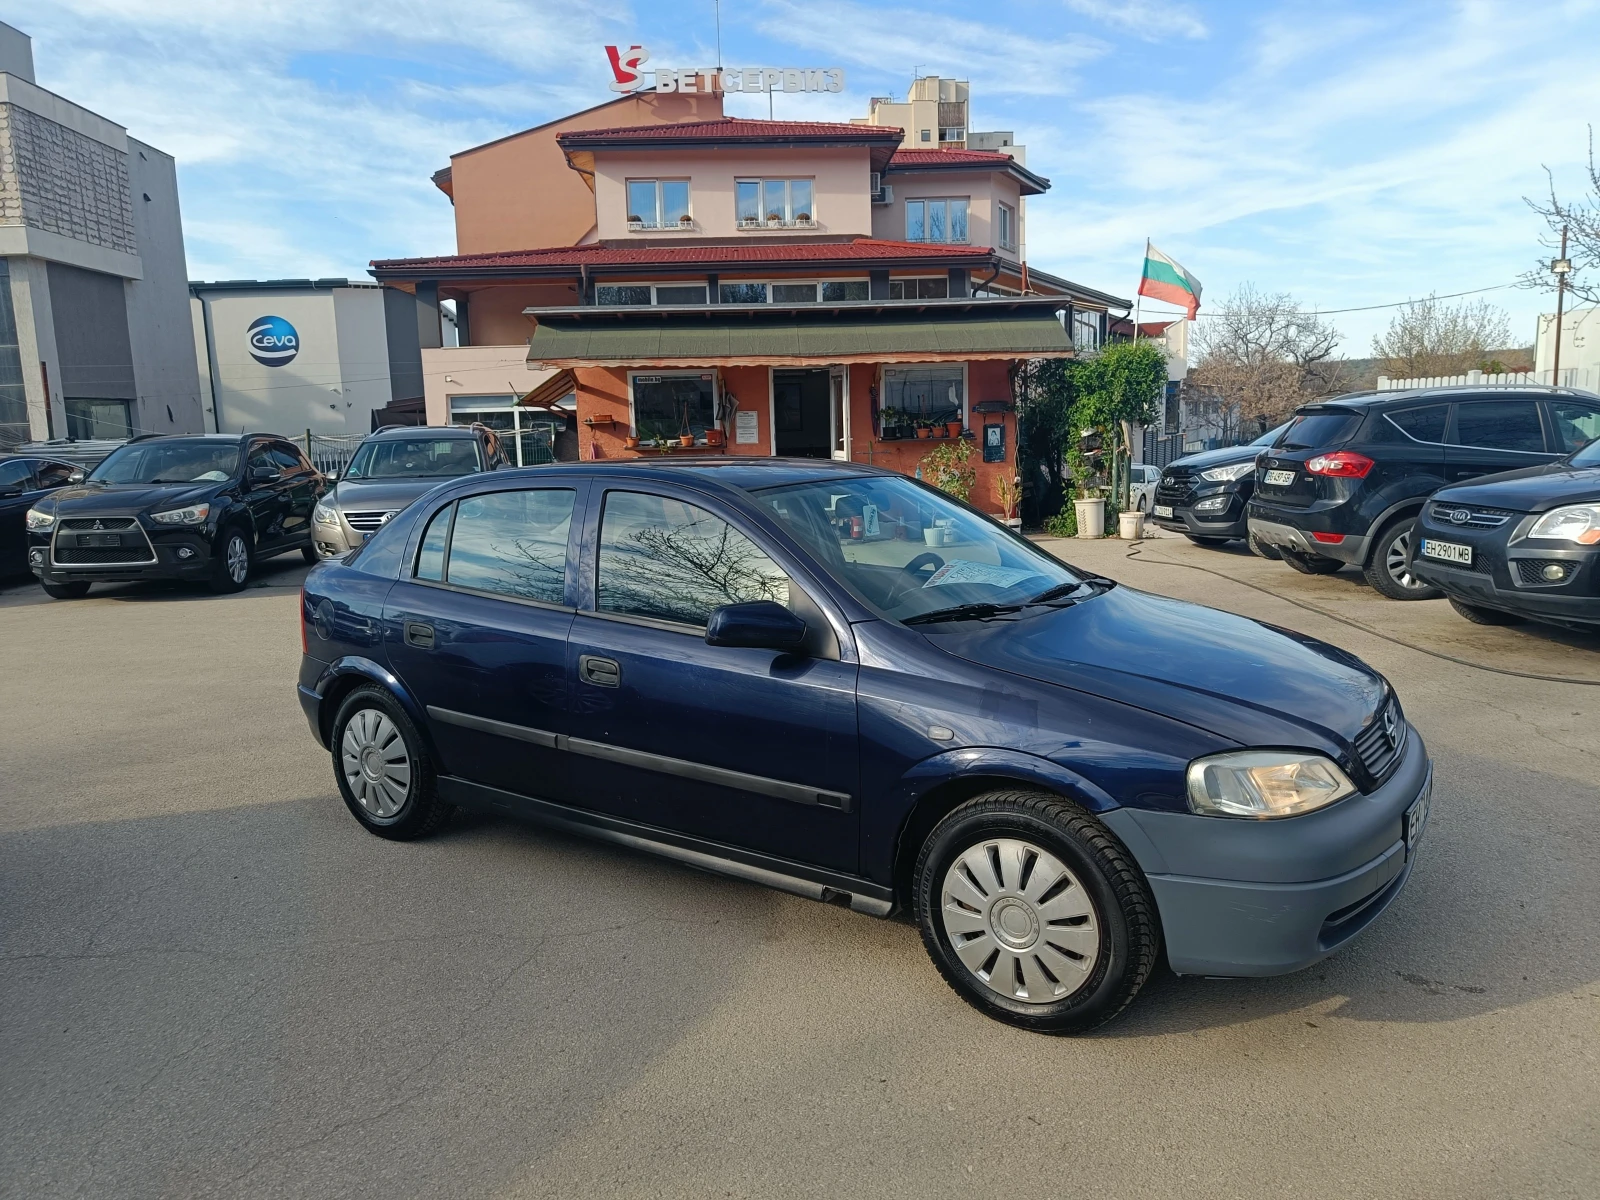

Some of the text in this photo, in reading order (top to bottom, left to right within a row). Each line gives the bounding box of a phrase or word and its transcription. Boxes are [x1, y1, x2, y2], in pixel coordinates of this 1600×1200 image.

[655, 68, 844, 93] ВЕТСЕРВИЗ
[1425, 541, 1470, 561] EH 2901 MB
